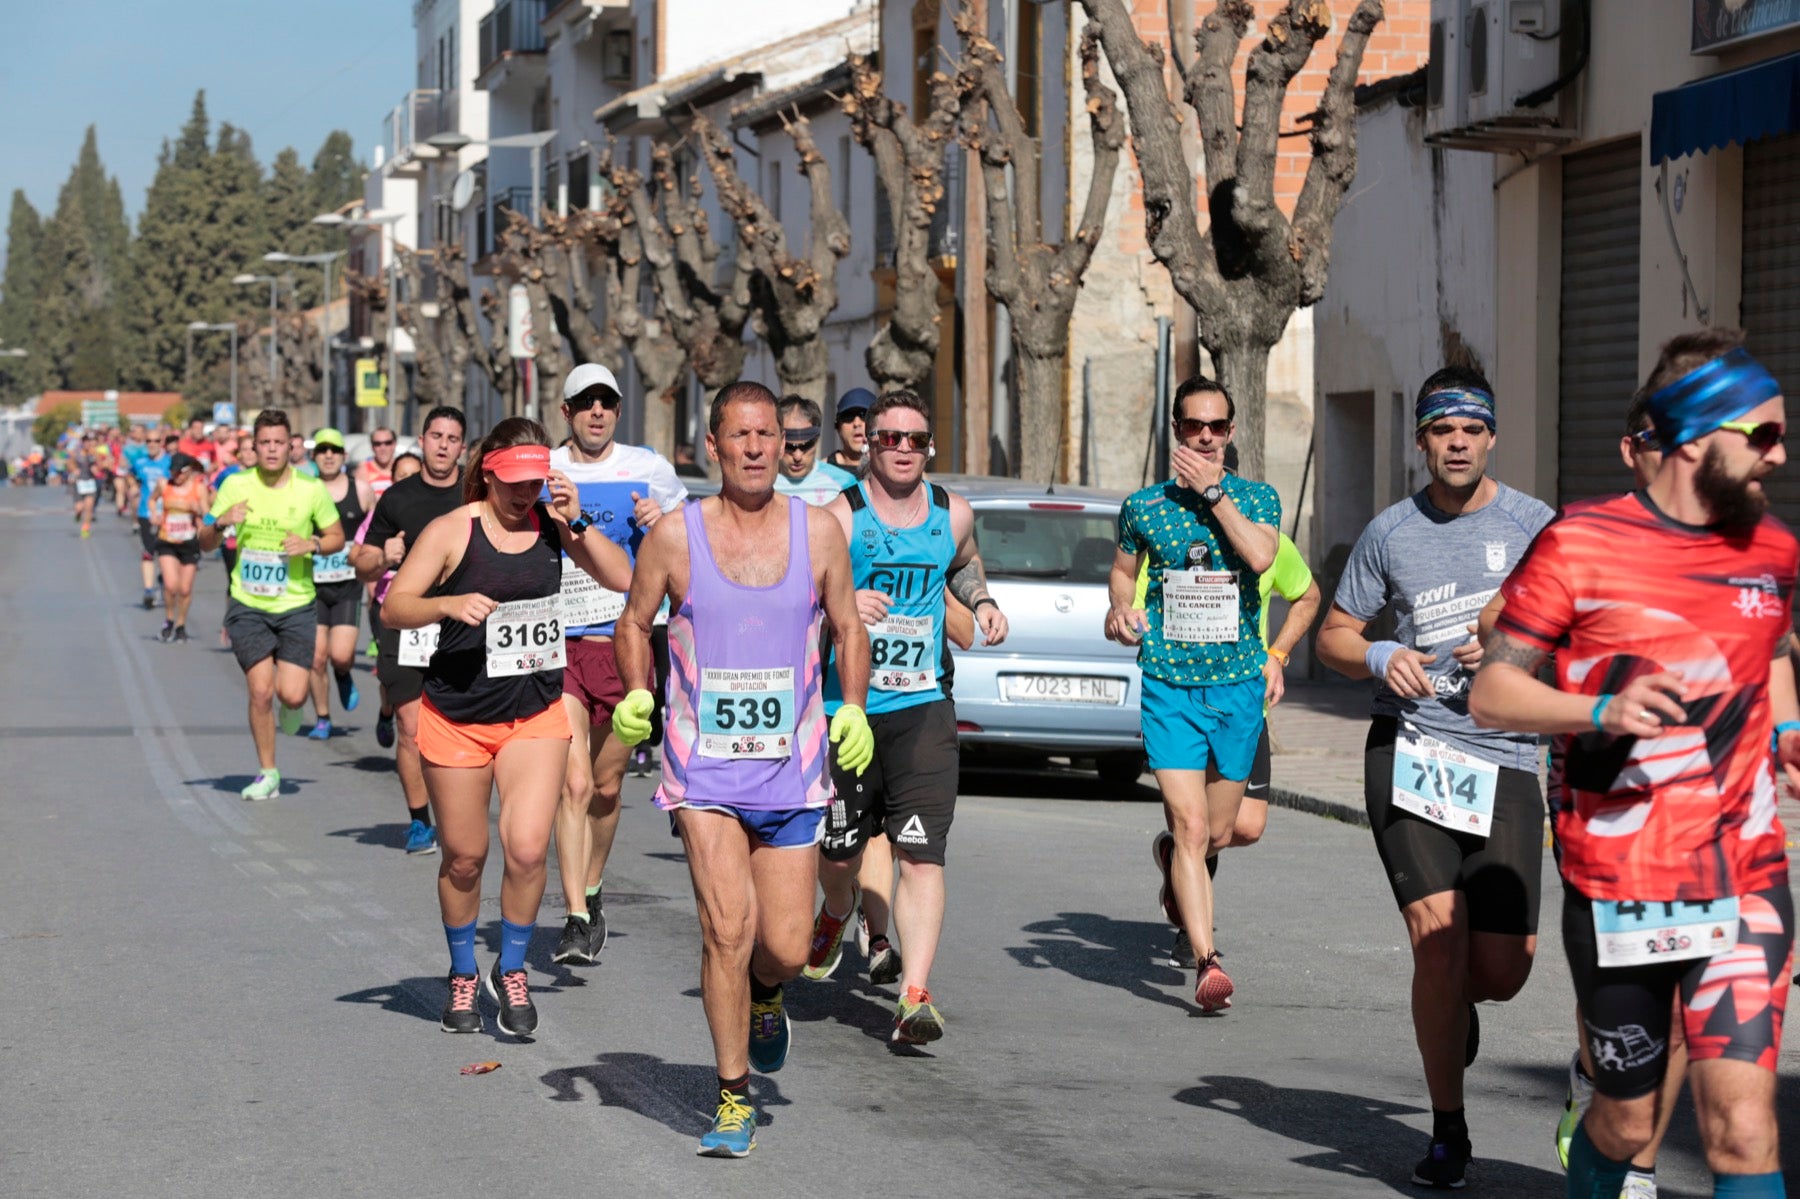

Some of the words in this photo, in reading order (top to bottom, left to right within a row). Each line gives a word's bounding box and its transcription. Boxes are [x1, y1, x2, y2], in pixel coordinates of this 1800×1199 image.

[243, 563, 287, 582] 1070
[1414, 582, 1457, 608] XXVII
[1176, 611, 1203, 620] aecc
[1414, 606, 1448, 620] PRUEBA
[1450, 601, 1462, 612] DE
[497, 618, 560, 649] 3163
[871, 637, 926, 668] 827
[722, 672, 739, 680] GRAN
[740, 671, 763, 680] PREMIO
[764, 671, 771, 680] DE
[730, 681, 768, 691] DIPUTACIÓN
[1024, 676, 1071, 695] 7023
[1080, 678, 1114, 698] FNL
[715, 697, 782, 730] 539
[1411, 761, 1478, 805] 784
[896, 834, 929, 845] Reebok
